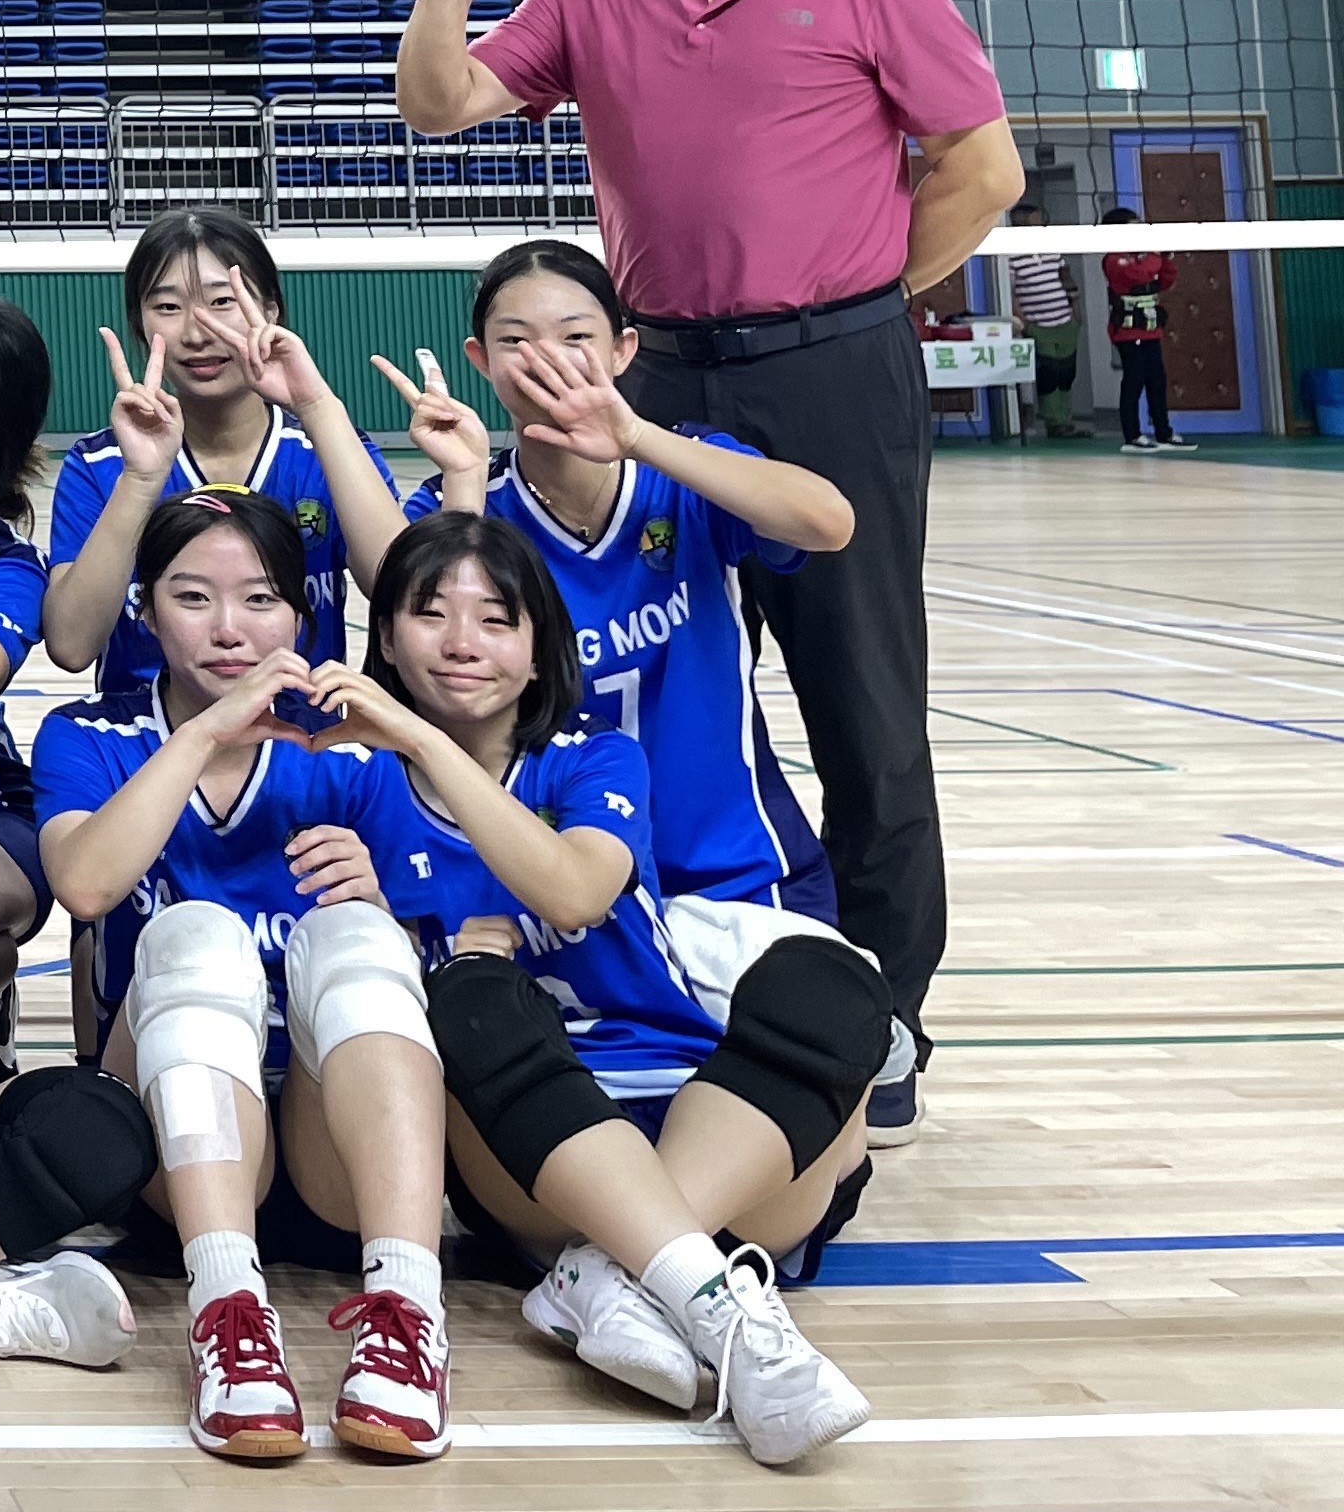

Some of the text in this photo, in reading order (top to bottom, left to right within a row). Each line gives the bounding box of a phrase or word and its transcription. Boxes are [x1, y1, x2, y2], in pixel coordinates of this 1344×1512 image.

[305, 571, 334, 612] ON
[593, 668, 640, 742] 7
[130, 875, 172, 918] SA
